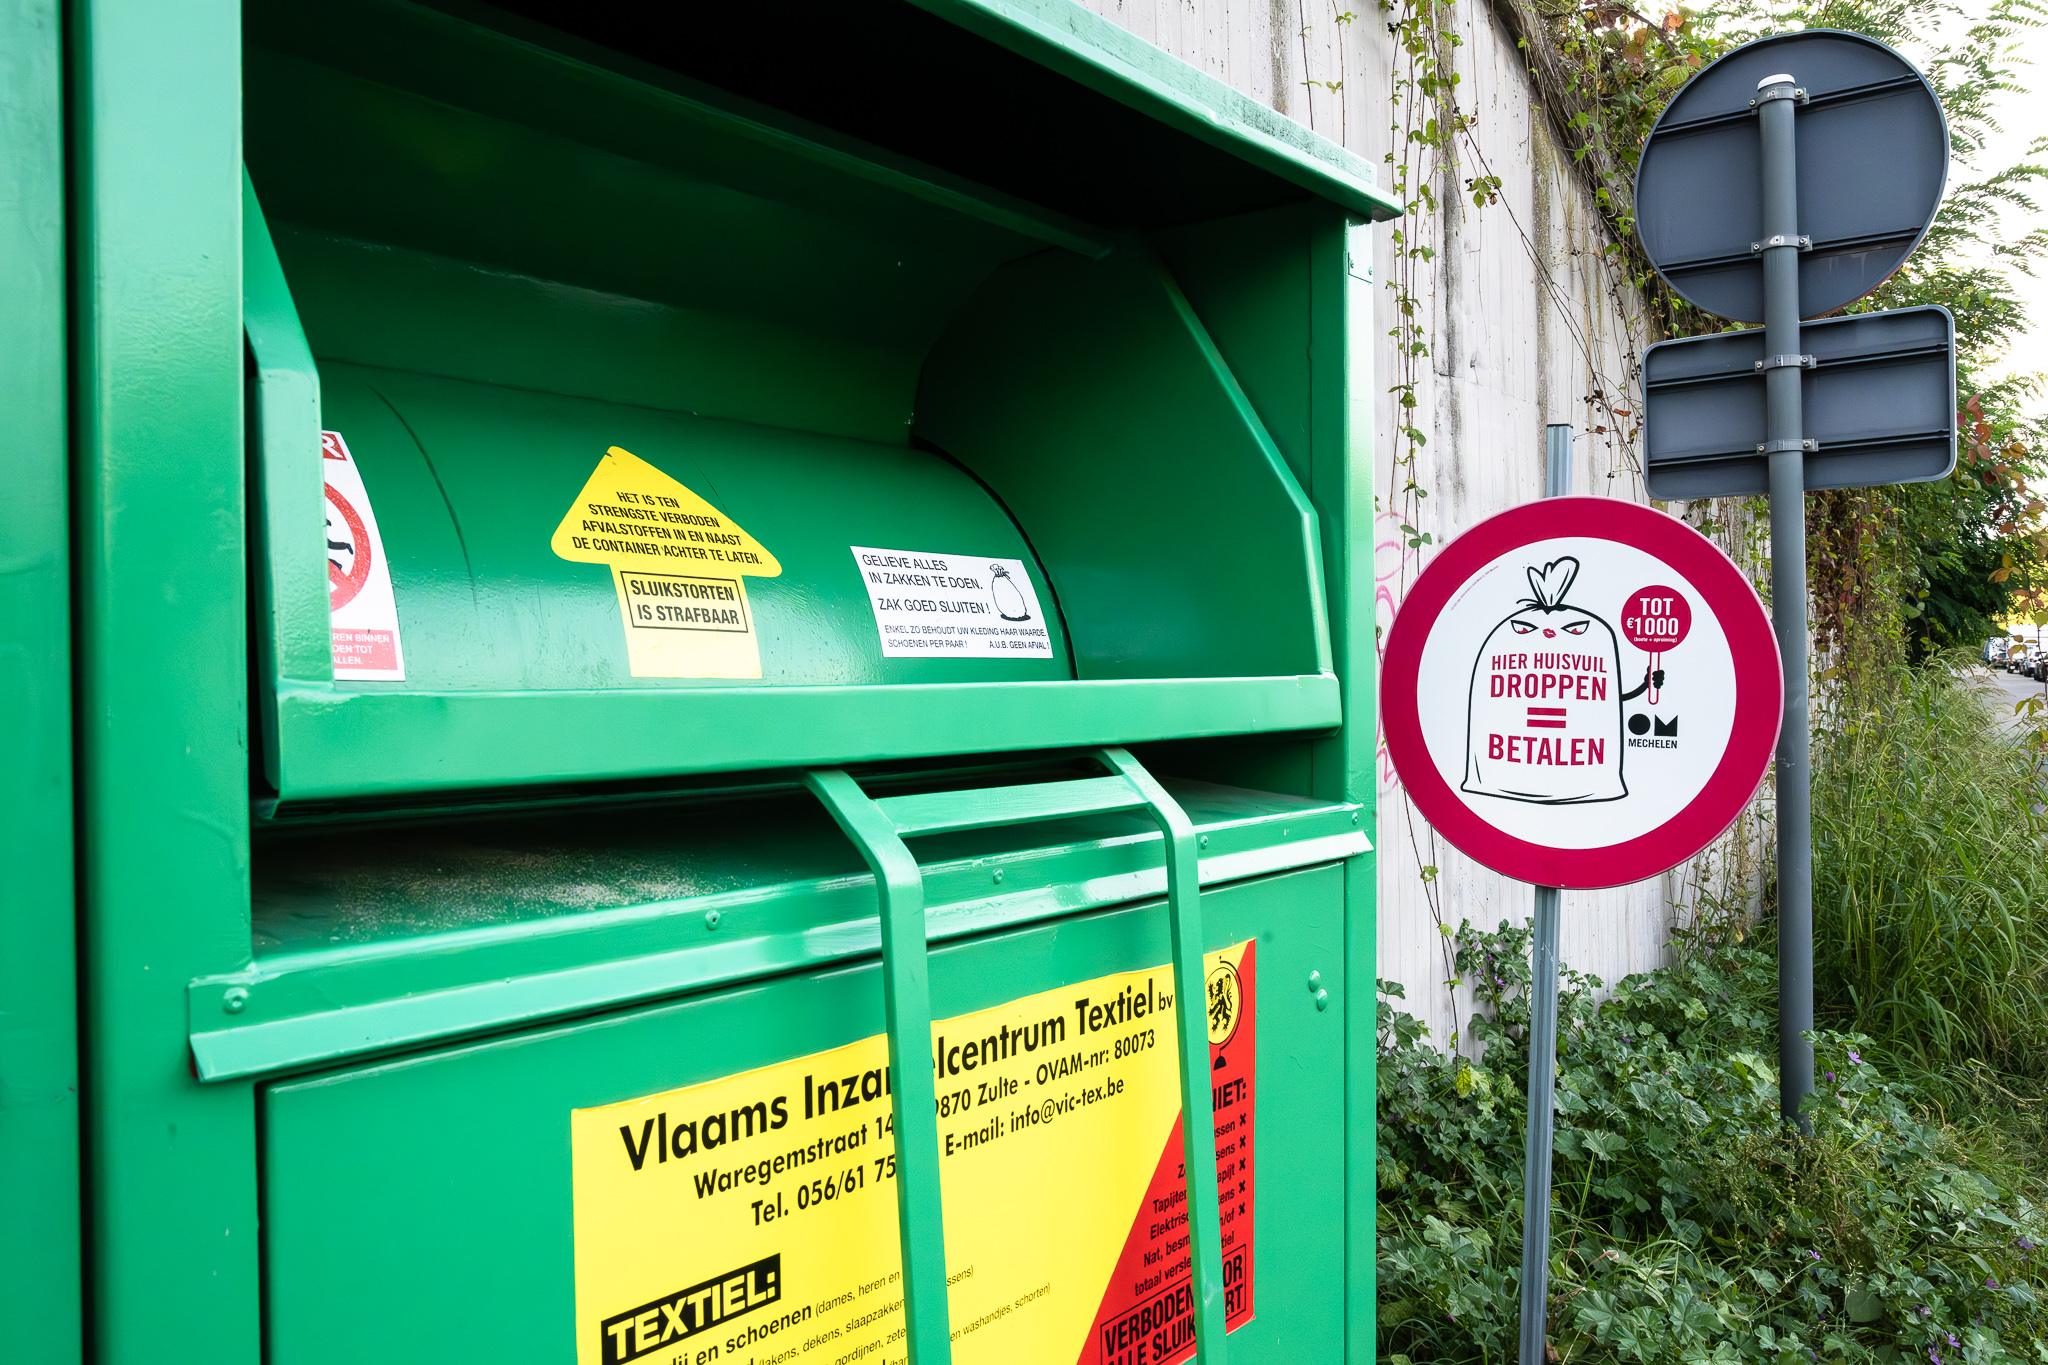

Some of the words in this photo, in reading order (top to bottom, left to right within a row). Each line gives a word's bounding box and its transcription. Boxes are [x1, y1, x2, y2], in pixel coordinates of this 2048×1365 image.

[616, 492, 639, 505] HET
[642, 495, 655, 506] IS
[657, 496, 680, 508] TEN
[588, 504, 659, 521] STRENGSTE
[660, 511, 720, 528] VERBODEN
[582, 520, 671, 539] AFVALSTOFFEN
[674, 530, 685, 540] IN
[689, 531, 704, 543] EN
[706, 533, 742, 546] NAAST
[572, 537, 589, 550] DE
[593, 538, 660, 555] CONTAINER
[664, 545, 708, 560] ACHTER
[709, 549, 724, 561] TE
[726, 551, 763, 564] LATEN.
[862, 554, 911, 568] GELIEVE
[913, 559, 948, 571] ALLES
[630, 580, 735, 601] SLUIKSTORTEN
[869, 572, 881, 584] IN
[884, 573, 931, 587] ZAKKEN
[931, 576, 947, 587] TE
[949, 577, 983, 589] DOEN.
[637, 604, 652, 620] IS
[656, 606, 740, 625] STRAFBAAR
[877, 598, 903, 611] ZAK
[904, 600, 937, 612] GOED
[1640, 598, 1673, 616] TOT
[355, 634, 390, 643] BINNEN
[885, 625, 909, 634] ENKEL
[910, 626, 920, 634] ZO
[922, 626, 956, 635] BEHOUDT
[957, 627, 969, 635] UW
[970, 627, 999, 636] KLEDING
[1000, 628, 1018, 636] HAAR
[1018, 629, 1046, 637] WAARDE.
[355, 645, 373, 654] TOT
[888, 639, 928, 648] SCHOENEN
[930, 640, 944, 648] PER
[989, 640, 1009, 649] A.U.B.
[1009, 641, 1027, 649] GEEN
[1492, 653, 1528, 671] HIER
[1534, 653, 1607, 673] HUISVUIL
[1490, 674, 1606, 701] DROPPEN
[1489, 734, 1604, 766] BETALEN
[1628, 738, 1678, 749] MECHELEN
[619, 1096, 788, 1171] Vlaams
[1075, 978, 1153, 1035] Textiel
[1158, 992, 1173, 1012] bv
[694, 1124, 867, 1199] Waregemstraat
[978, 1077, 1018, 1106] Zulte
[1036, 1049, 1109, 1085] OVAM-nr:
[1114, 1029, 1155, 1059] 80073
[751, 1192, 788, 1226] Tel.
[797, 1165, 864, 1210] 056/61
[945, 1116, 1004, 1157] E-mail:
[1010, 1077, 1124, 1132] info@vic-tex.be
[1135, 1270, 1162, 1296] totaal
[1222, 1231, 1234, 1249] tiel
[1144, 1248, 1163, 1268] Nat,
[608, 1270, 776, 1360] TEXTIEL:
[696, 1345, 718, 1365] en
[726, 1303, 812, 1354] schoenen
[815, 1291, 856, 1318] (dames,
[858, 1277, 886, 1297] heren
[888, 1271, 900, 1283] en
[802, 1327, 843, 1352] dekens,
[946, 1265, 974, 1287] ssens)
[963, 1304, 1013, 1335] washandjes,
[1015, 1282, 1051, 1309] schorten)
